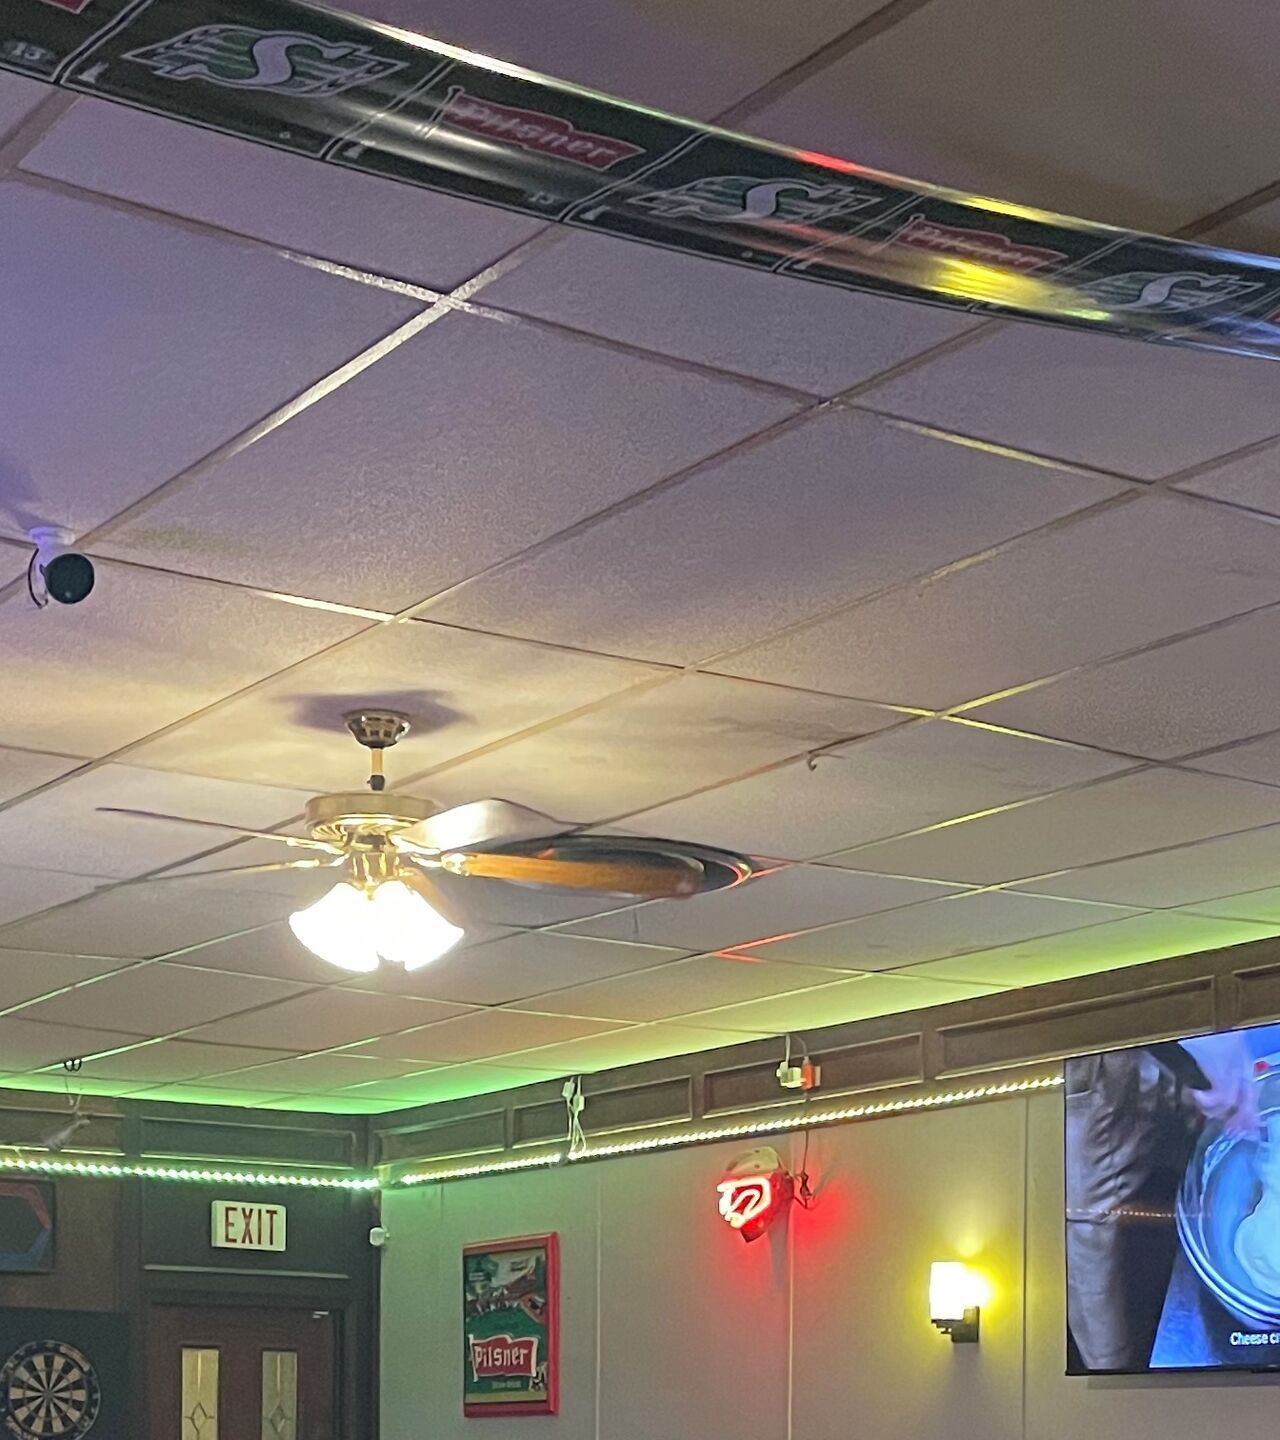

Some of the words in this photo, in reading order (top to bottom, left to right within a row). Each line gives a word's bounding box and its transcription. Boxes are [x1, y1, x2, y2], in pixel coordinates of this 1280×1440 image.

[224, 1206, 278, 1246] EXIT
[1230, 1331, 1269, 1346] Cheese
[473, 1345, 529, 1369] Pilsner
